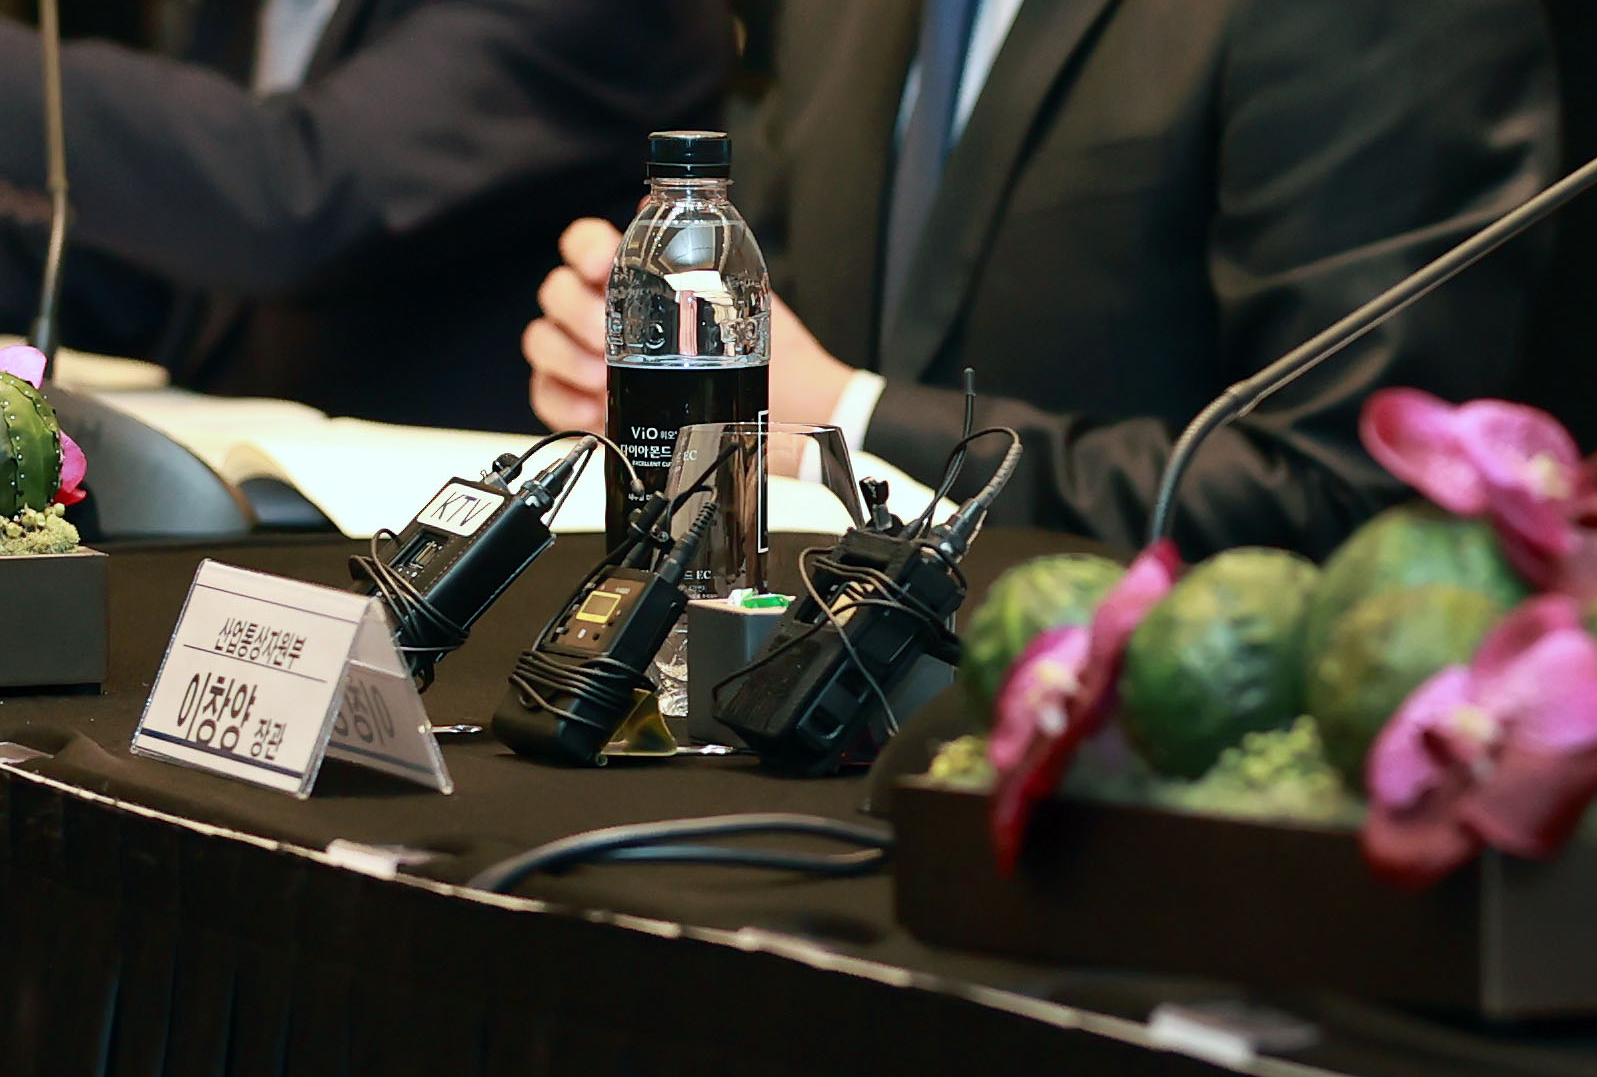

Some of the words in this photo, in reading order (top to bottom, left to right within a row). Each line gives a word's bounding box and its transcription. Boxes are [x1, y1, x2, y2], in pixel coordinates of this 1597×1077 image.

[631, 426, 658, 440] ViO
[430, 491, 492, 527] KTV
[696, 569, 712, 580] EC
[214, 617, 307, 670] 산업통상자원부
[177, 672, 258, 752] 이창양
[250, 718, 287, 761] 장관
